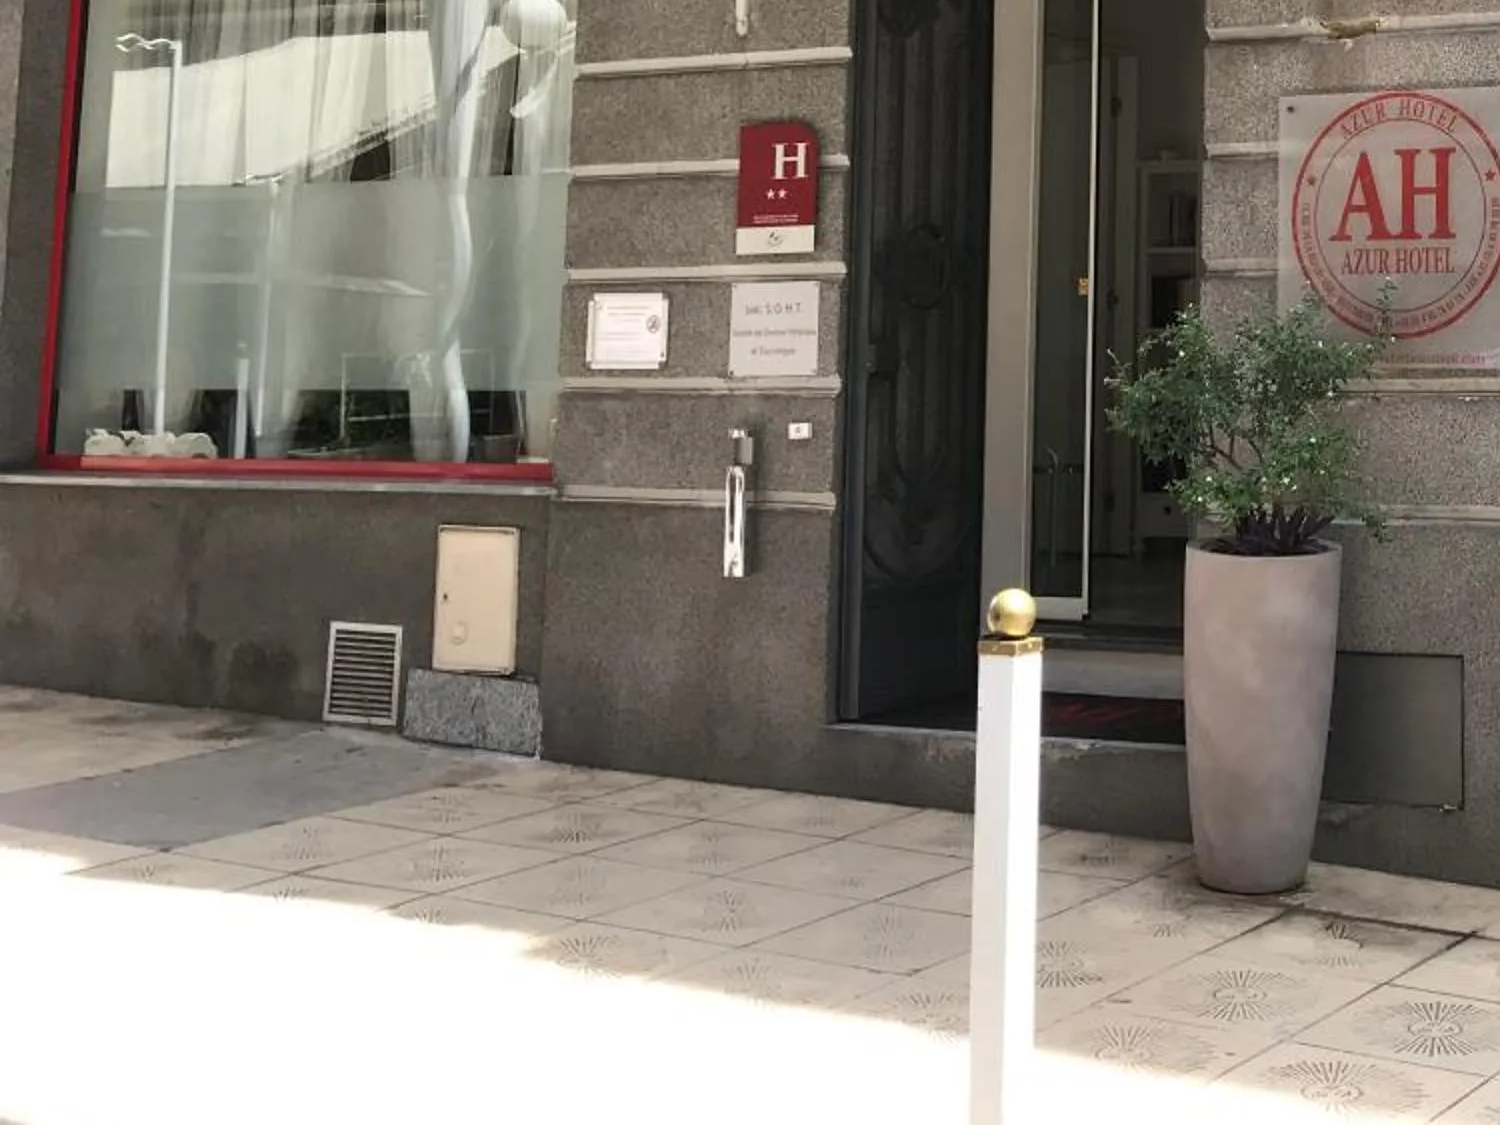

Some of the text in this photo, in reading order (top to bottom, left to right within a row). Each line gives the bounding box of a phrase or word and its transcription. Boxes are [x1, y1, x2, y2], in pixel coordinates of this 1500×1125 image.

[1399, 98, 1458, 133] HOTEL
[772, 142, 810, 179] H
[1328, 146, 1457, 242] AH
[1341, 247, 1455, 275] AZUR HOTEL
